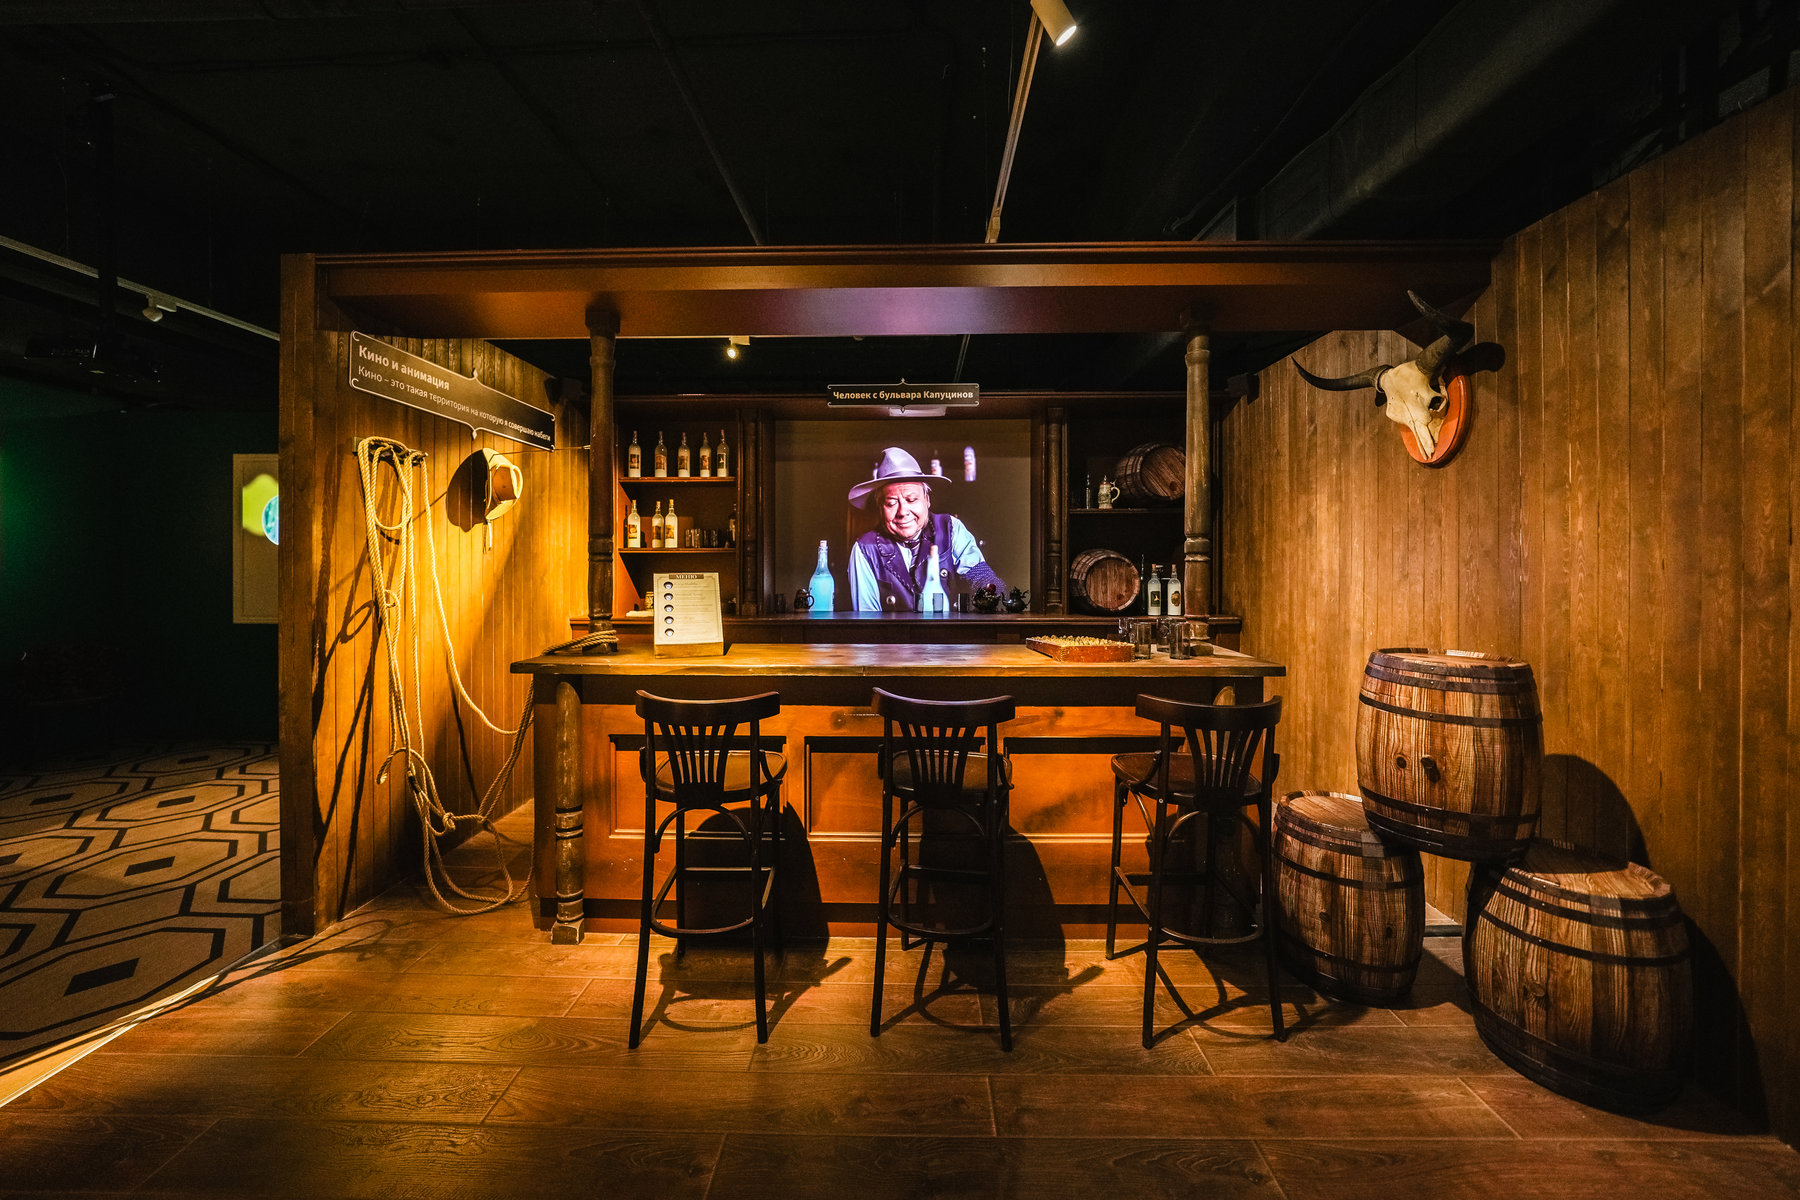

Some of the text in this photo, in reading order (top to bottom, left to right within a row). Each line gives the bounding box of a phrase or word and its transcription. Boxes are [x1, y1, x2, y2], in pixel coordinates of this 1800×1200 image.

[359, 345, 450, 391] Кино и анимация
[358, 365, 382, 382] Кино
[390, 378, 405, 390] это
[406, 384, 428, 398] такая
[429, 392, 470, 412] территория
[470, 408, 479, 416] на
[479, 412, 503, 425] которую
[833, 391, 871, 400] Человек
[879, 390, 922, 401] бульвара
[923, 391, 974, 401] Капуцинов
